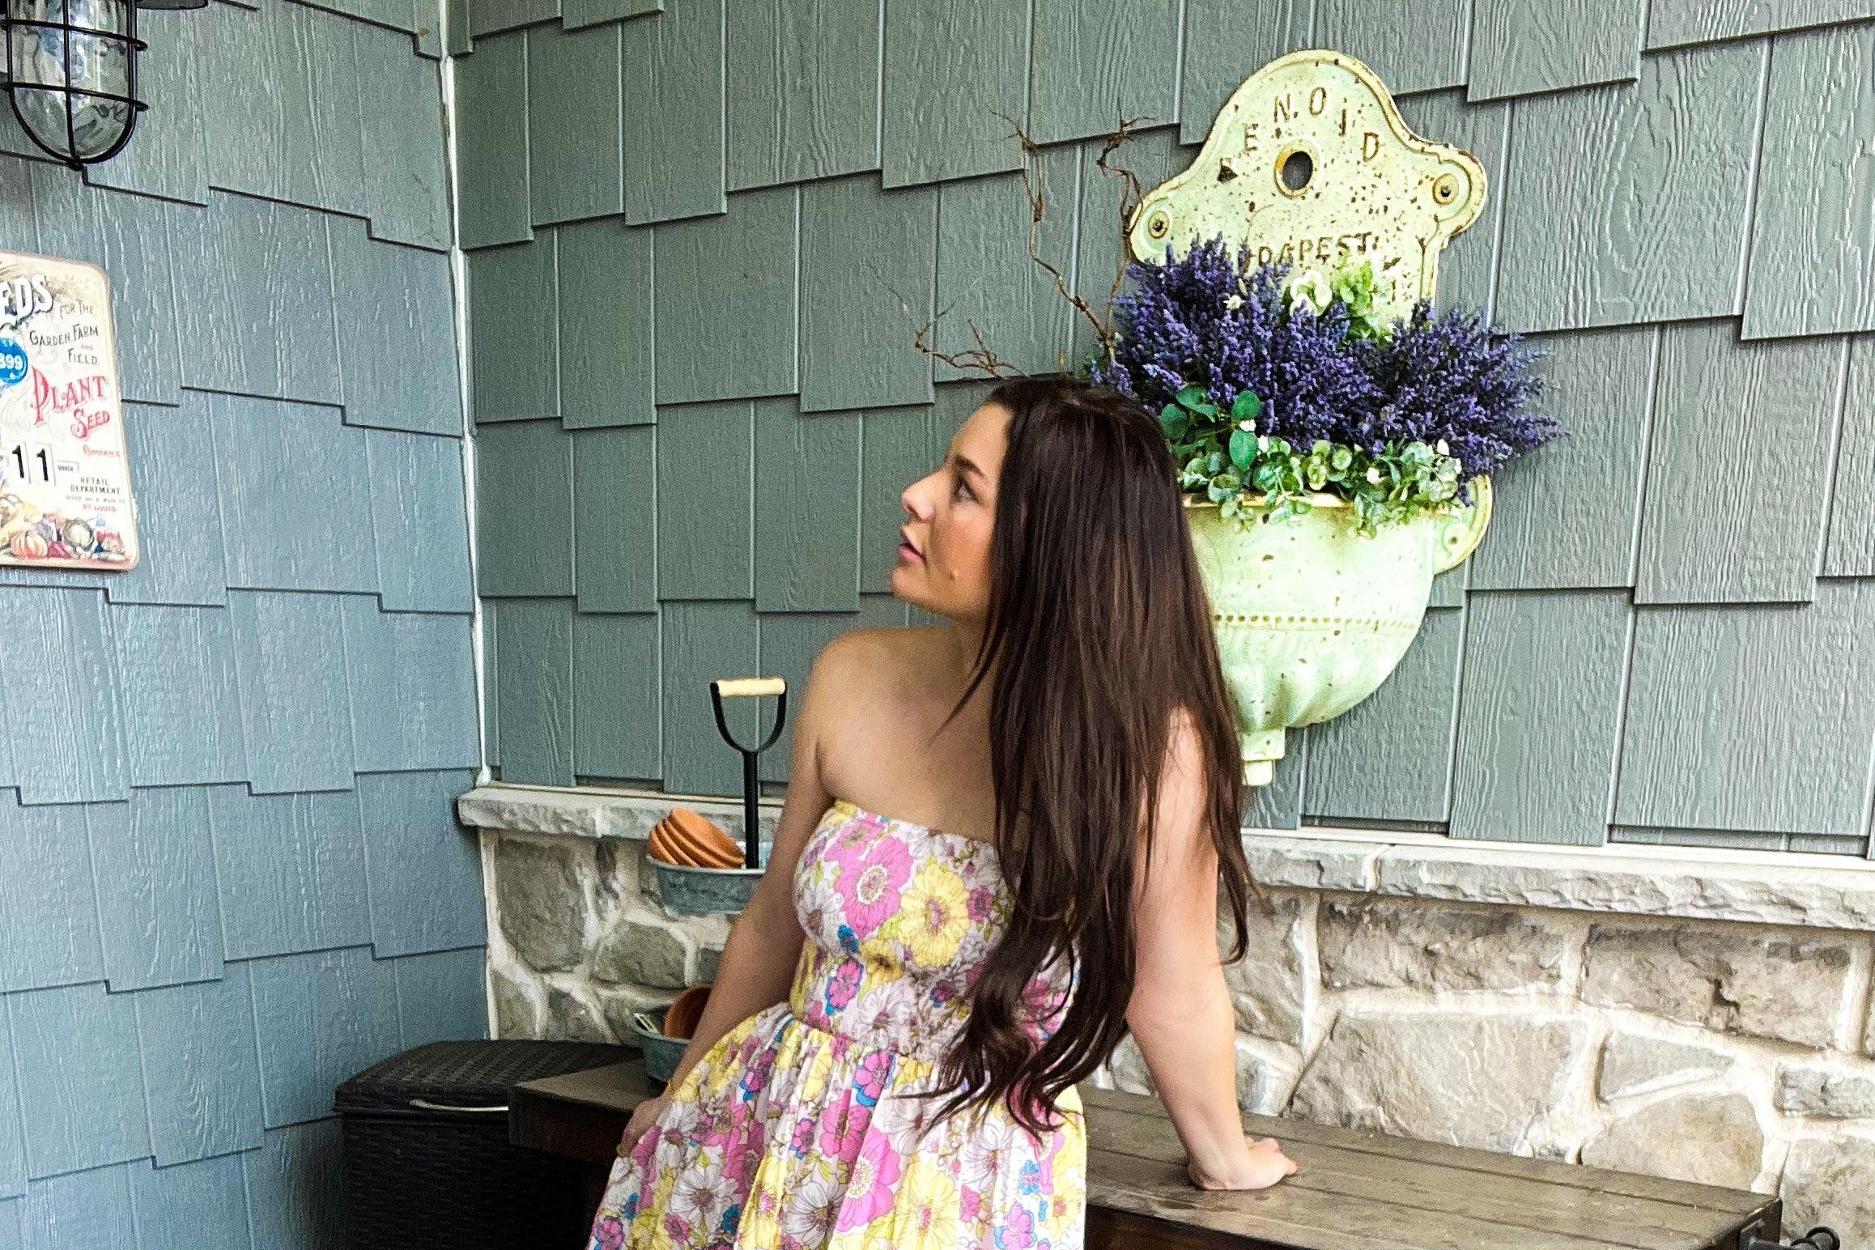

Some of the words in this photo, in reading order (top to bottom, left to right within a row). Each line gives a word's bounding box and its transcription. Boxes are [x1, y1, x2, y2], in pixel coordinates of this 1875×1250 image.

[0, 274, 54, 328] EDS
[60, 304, 76, 320] FOR
[72, 323, 99, 342] FARM
[31, 366, 107, 427] PLANT
[70, 406, 111, 440] SEED
